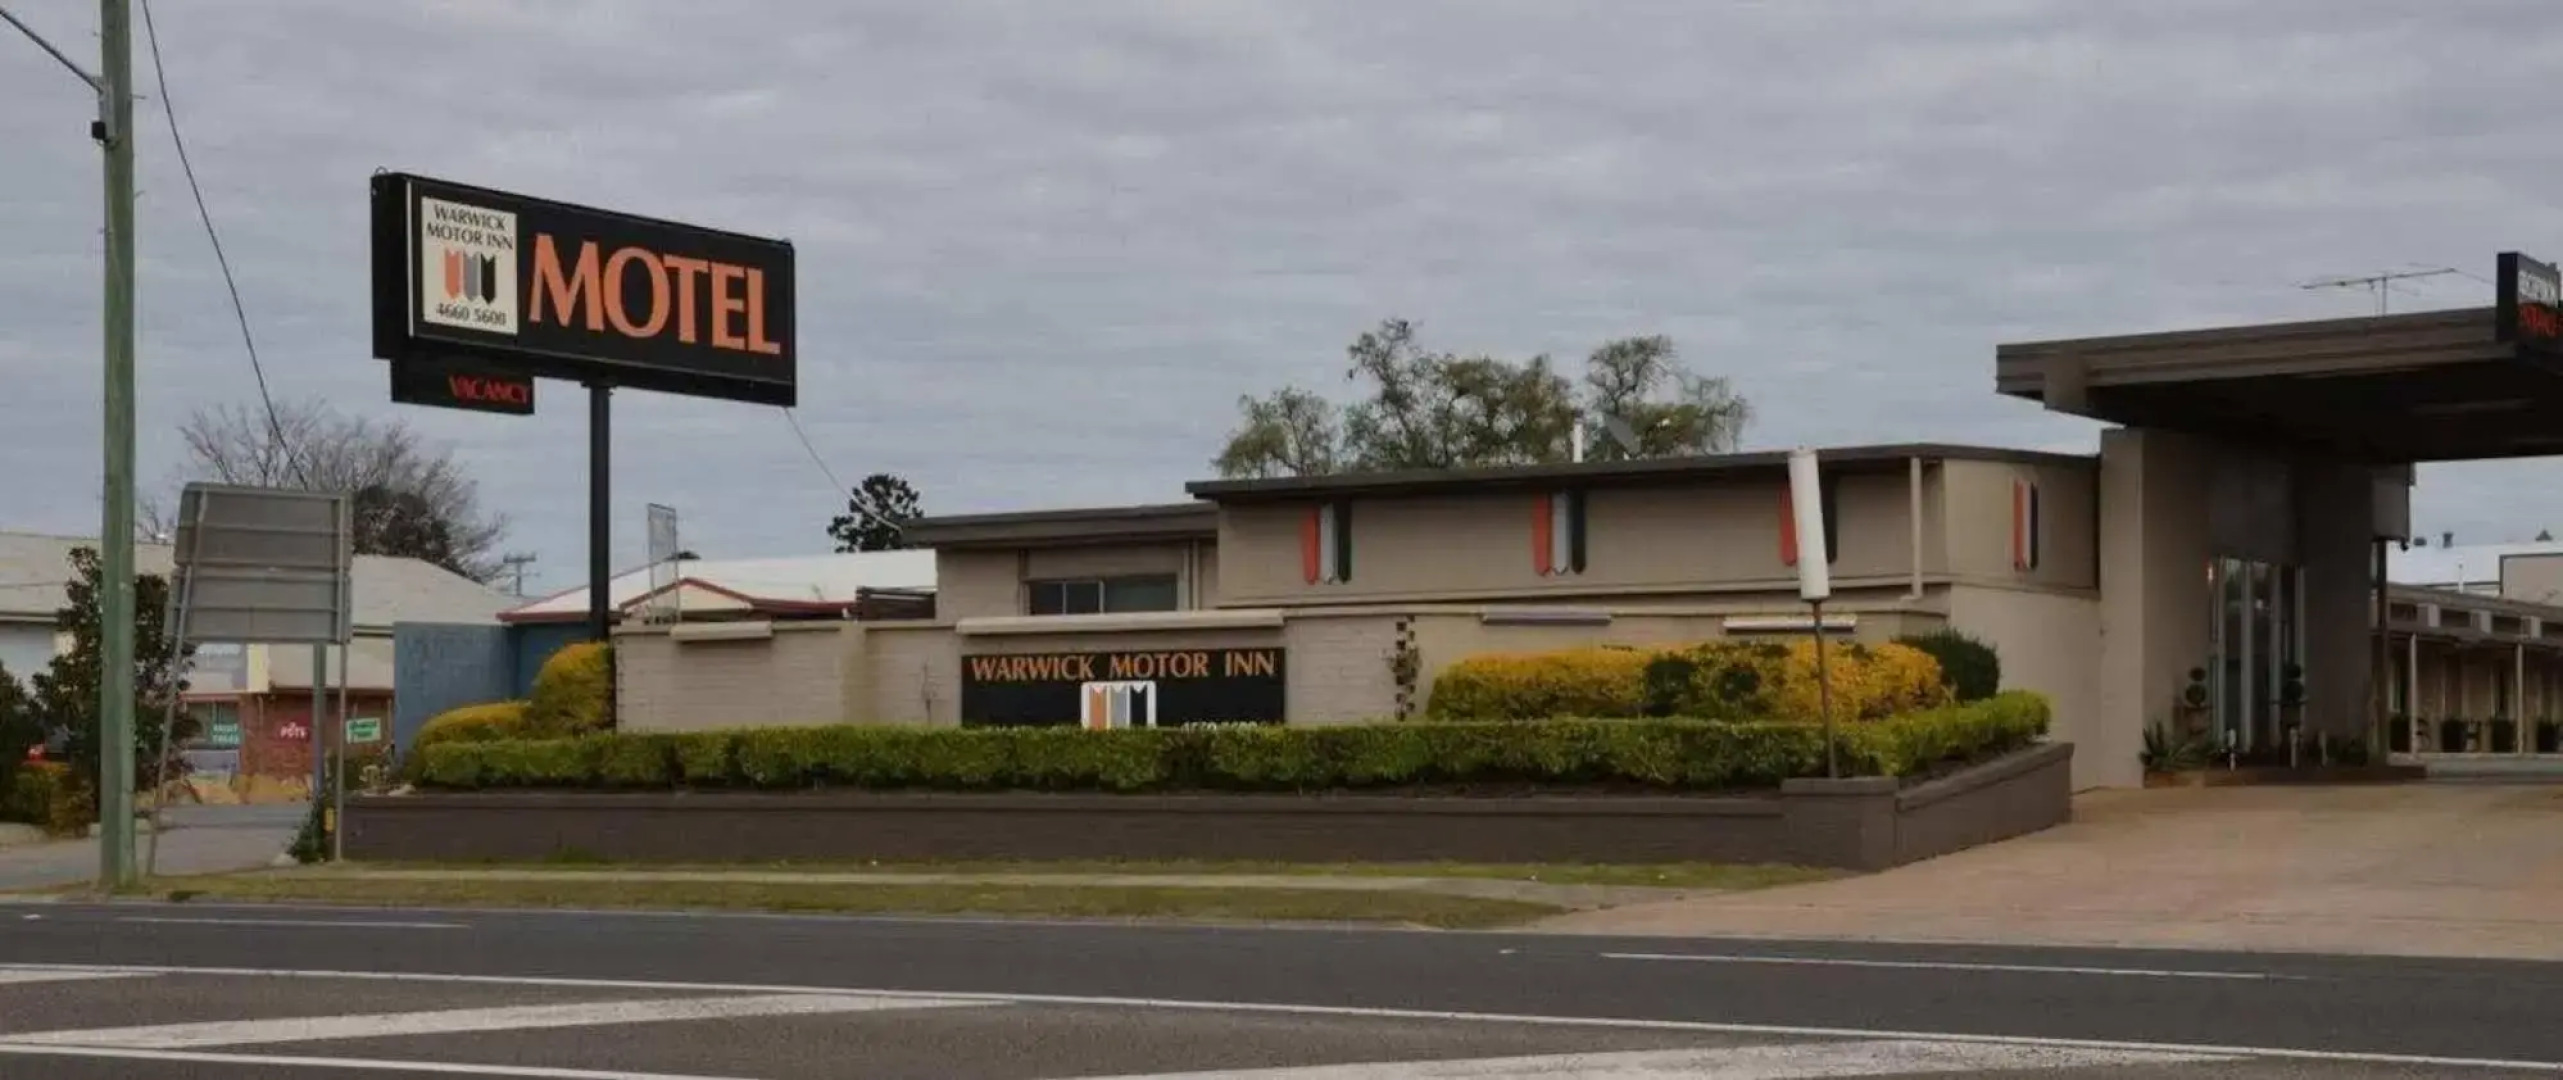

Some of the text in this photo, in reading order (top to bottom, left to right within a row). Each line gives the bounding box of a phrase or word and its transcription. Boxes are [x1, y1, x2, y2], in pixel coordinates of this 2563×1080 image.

[434, 204, 507, 231] WARWICK
[427, 222, 513, 250] MOTOR INN
[528, 233, 781, 355] MOTEL
[436, 302, 469, 321] 4660
[448, 375, 528, 405] VACANCY
[970, 651, 1276, 682] WARWICK MOTOR INN
